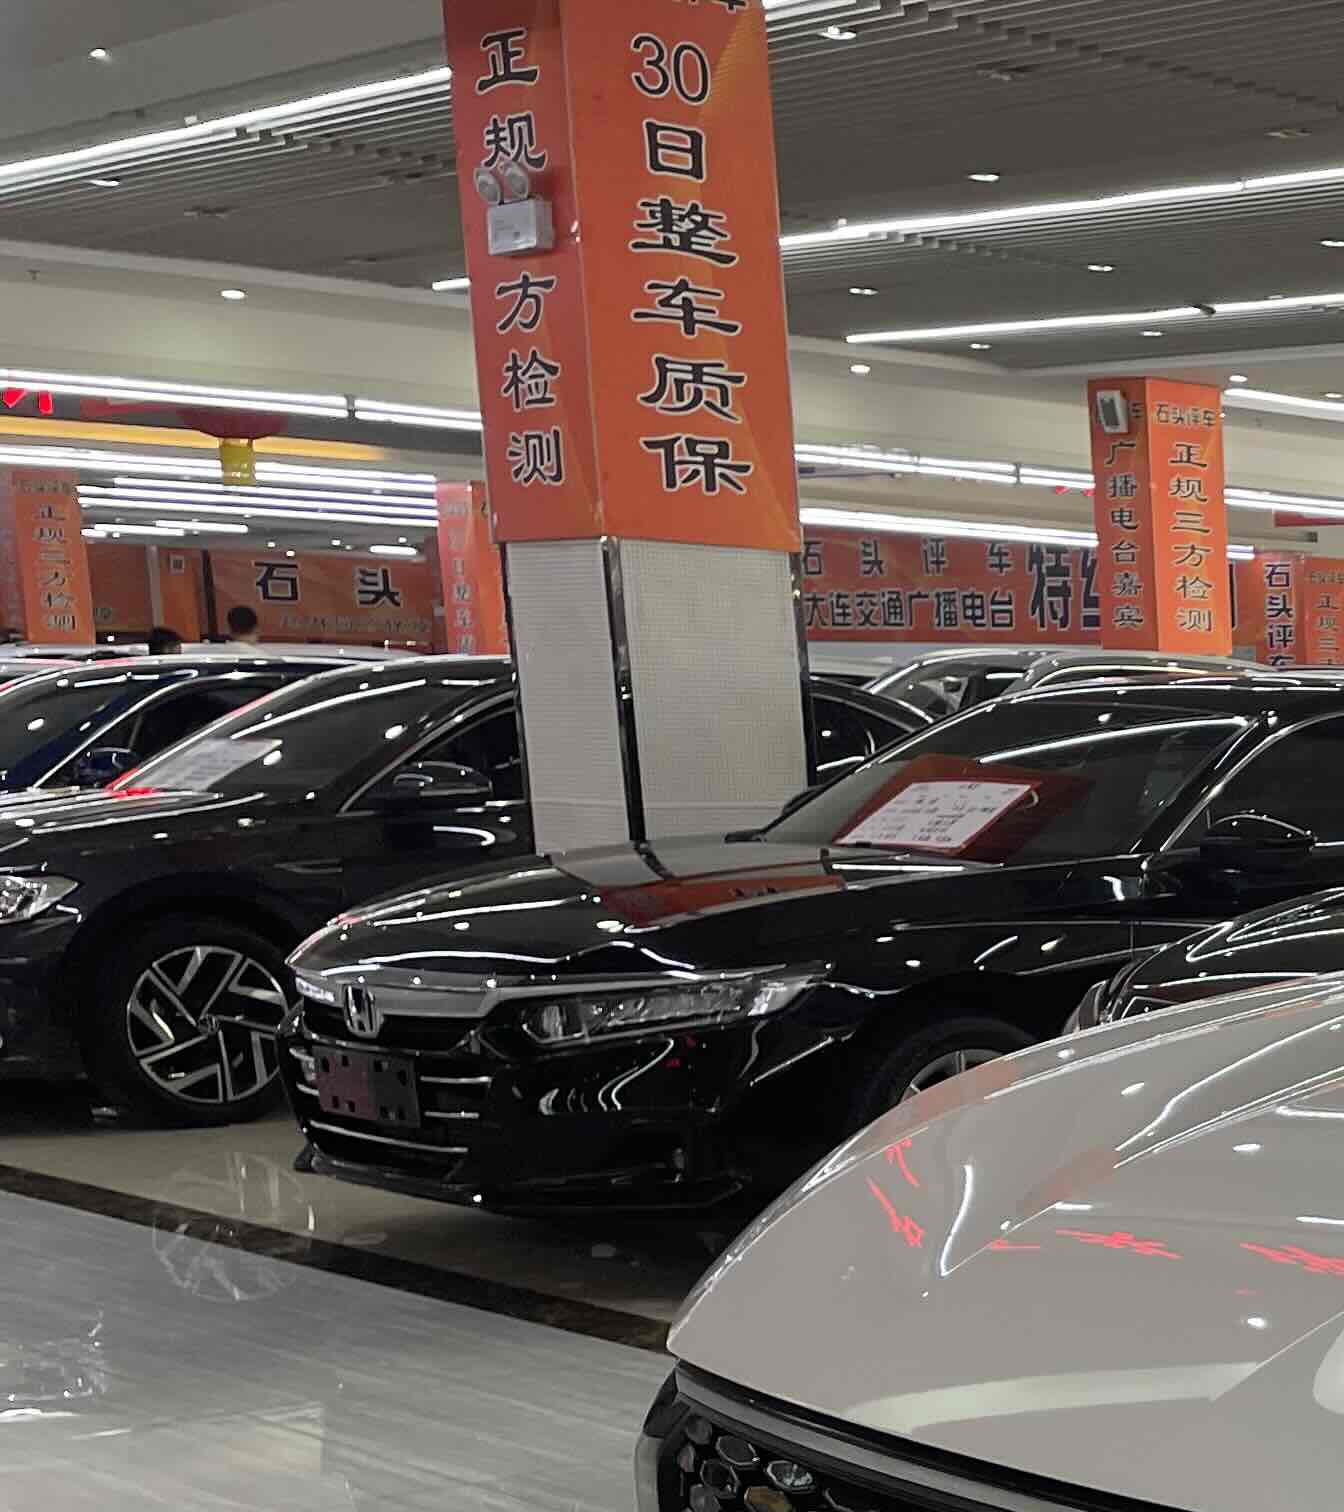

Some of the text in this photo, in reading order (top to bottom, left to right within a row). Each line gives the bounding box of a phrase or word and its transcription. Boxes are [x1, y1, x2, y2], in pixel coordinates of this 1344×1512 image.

[476, 26, 563, 487] 正规方检测
[631, 33, 753, 495] 30日整车质保
[802, 537, 1017, 577] 石头评车
[804, 589, 1016, 631] 大连交通广播电台
[1105, 440, 1144, 630] 广播电台嘉宾
[1168, 442, 1213, 633] 正规三方检测
